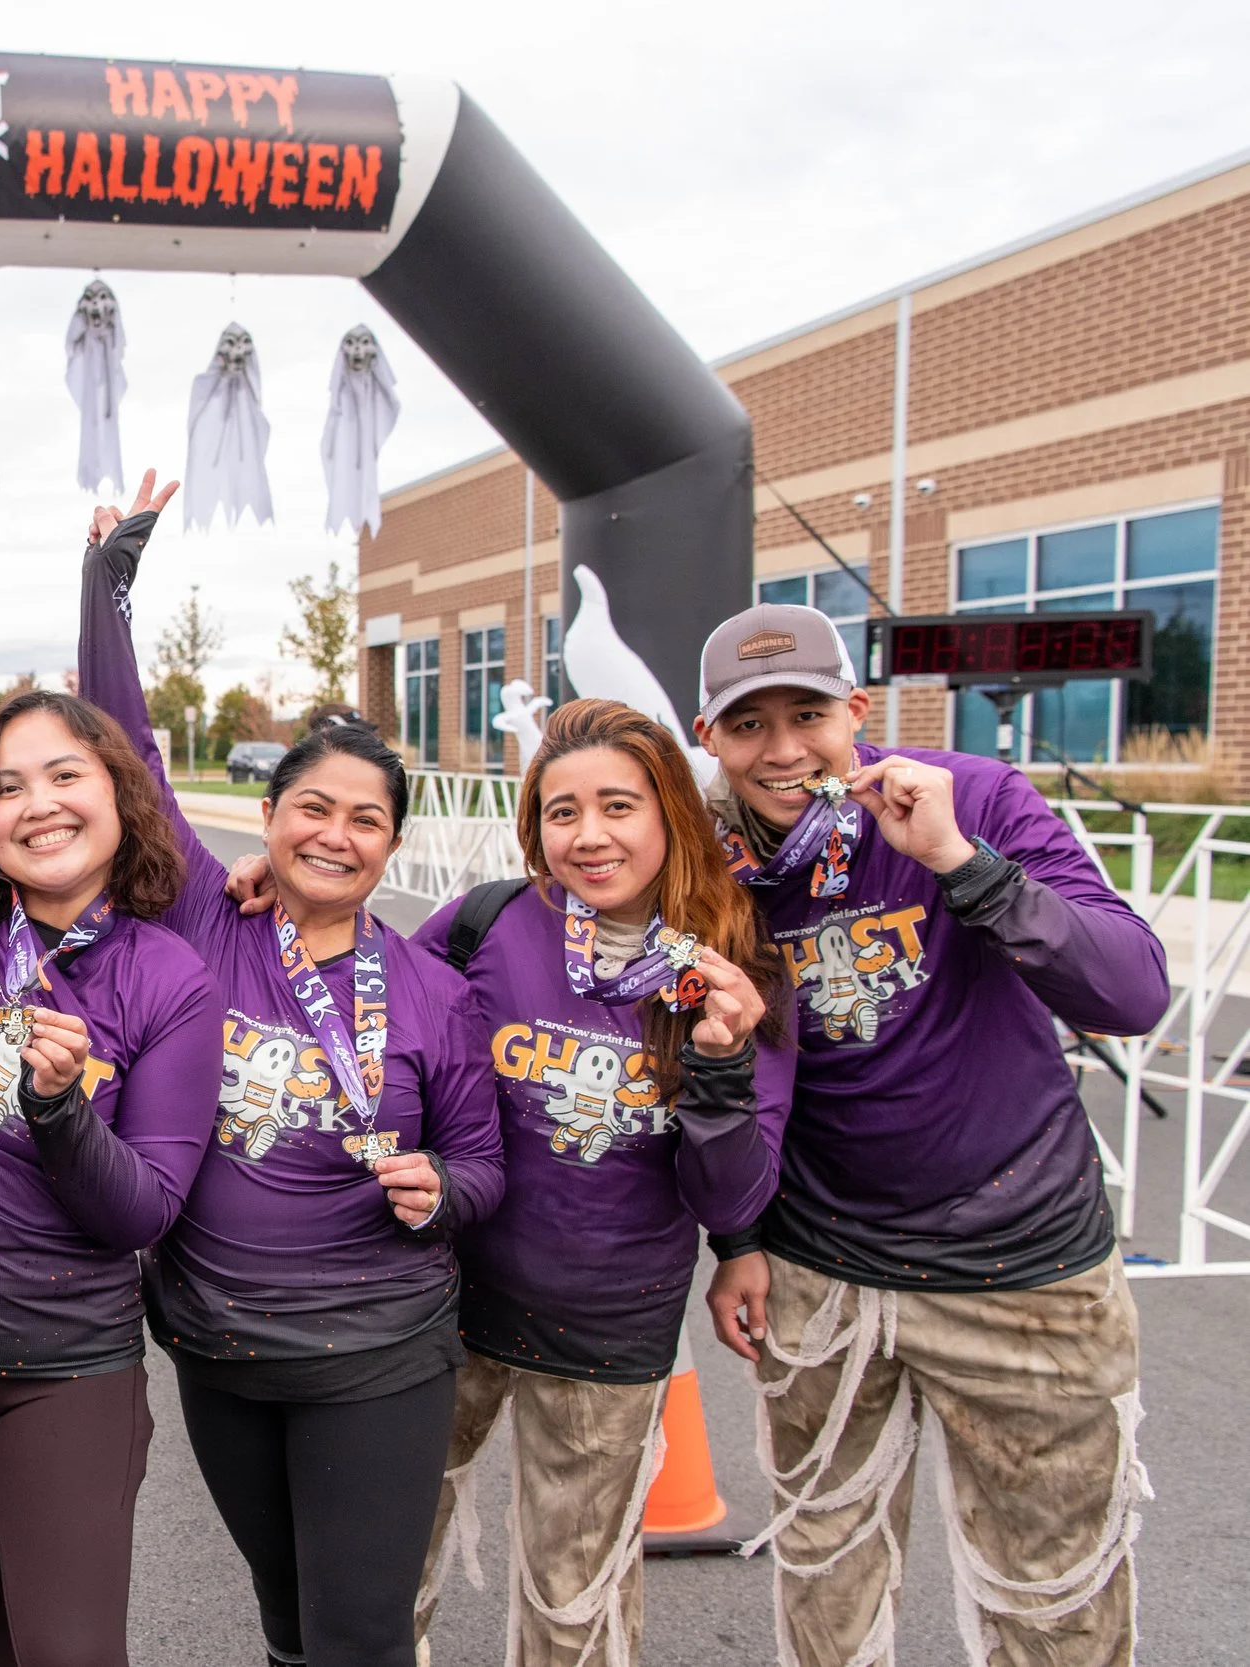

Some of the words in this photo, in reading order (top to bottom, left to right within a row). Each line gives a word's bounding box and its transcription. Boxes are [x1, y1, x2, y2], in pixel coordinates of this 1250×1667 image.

[105, 66, 299, 132] HAPPY
[24, 129, 381, 214] HALLOWEEN
[741, 637, 791, 655] MARINES
[354, 950, 386, 995] 5K
[868, 951, 931, 1000] 5K
[226, 1008, 275, 1033] scarecrow
[295, 974, 341, 1029] 5K
[354, 996, 388, 1097] GHOST
[534, 1018, 590, 1037] scarecrow
[590, 1032, 625, 1046] sprint
[624, 1036, 643, 1050] fun
[285, 1098, 355, 1133] 5K
[619, 1105, 680, 1135] 5K
[342, 1131, 400, 1154] GHOST
